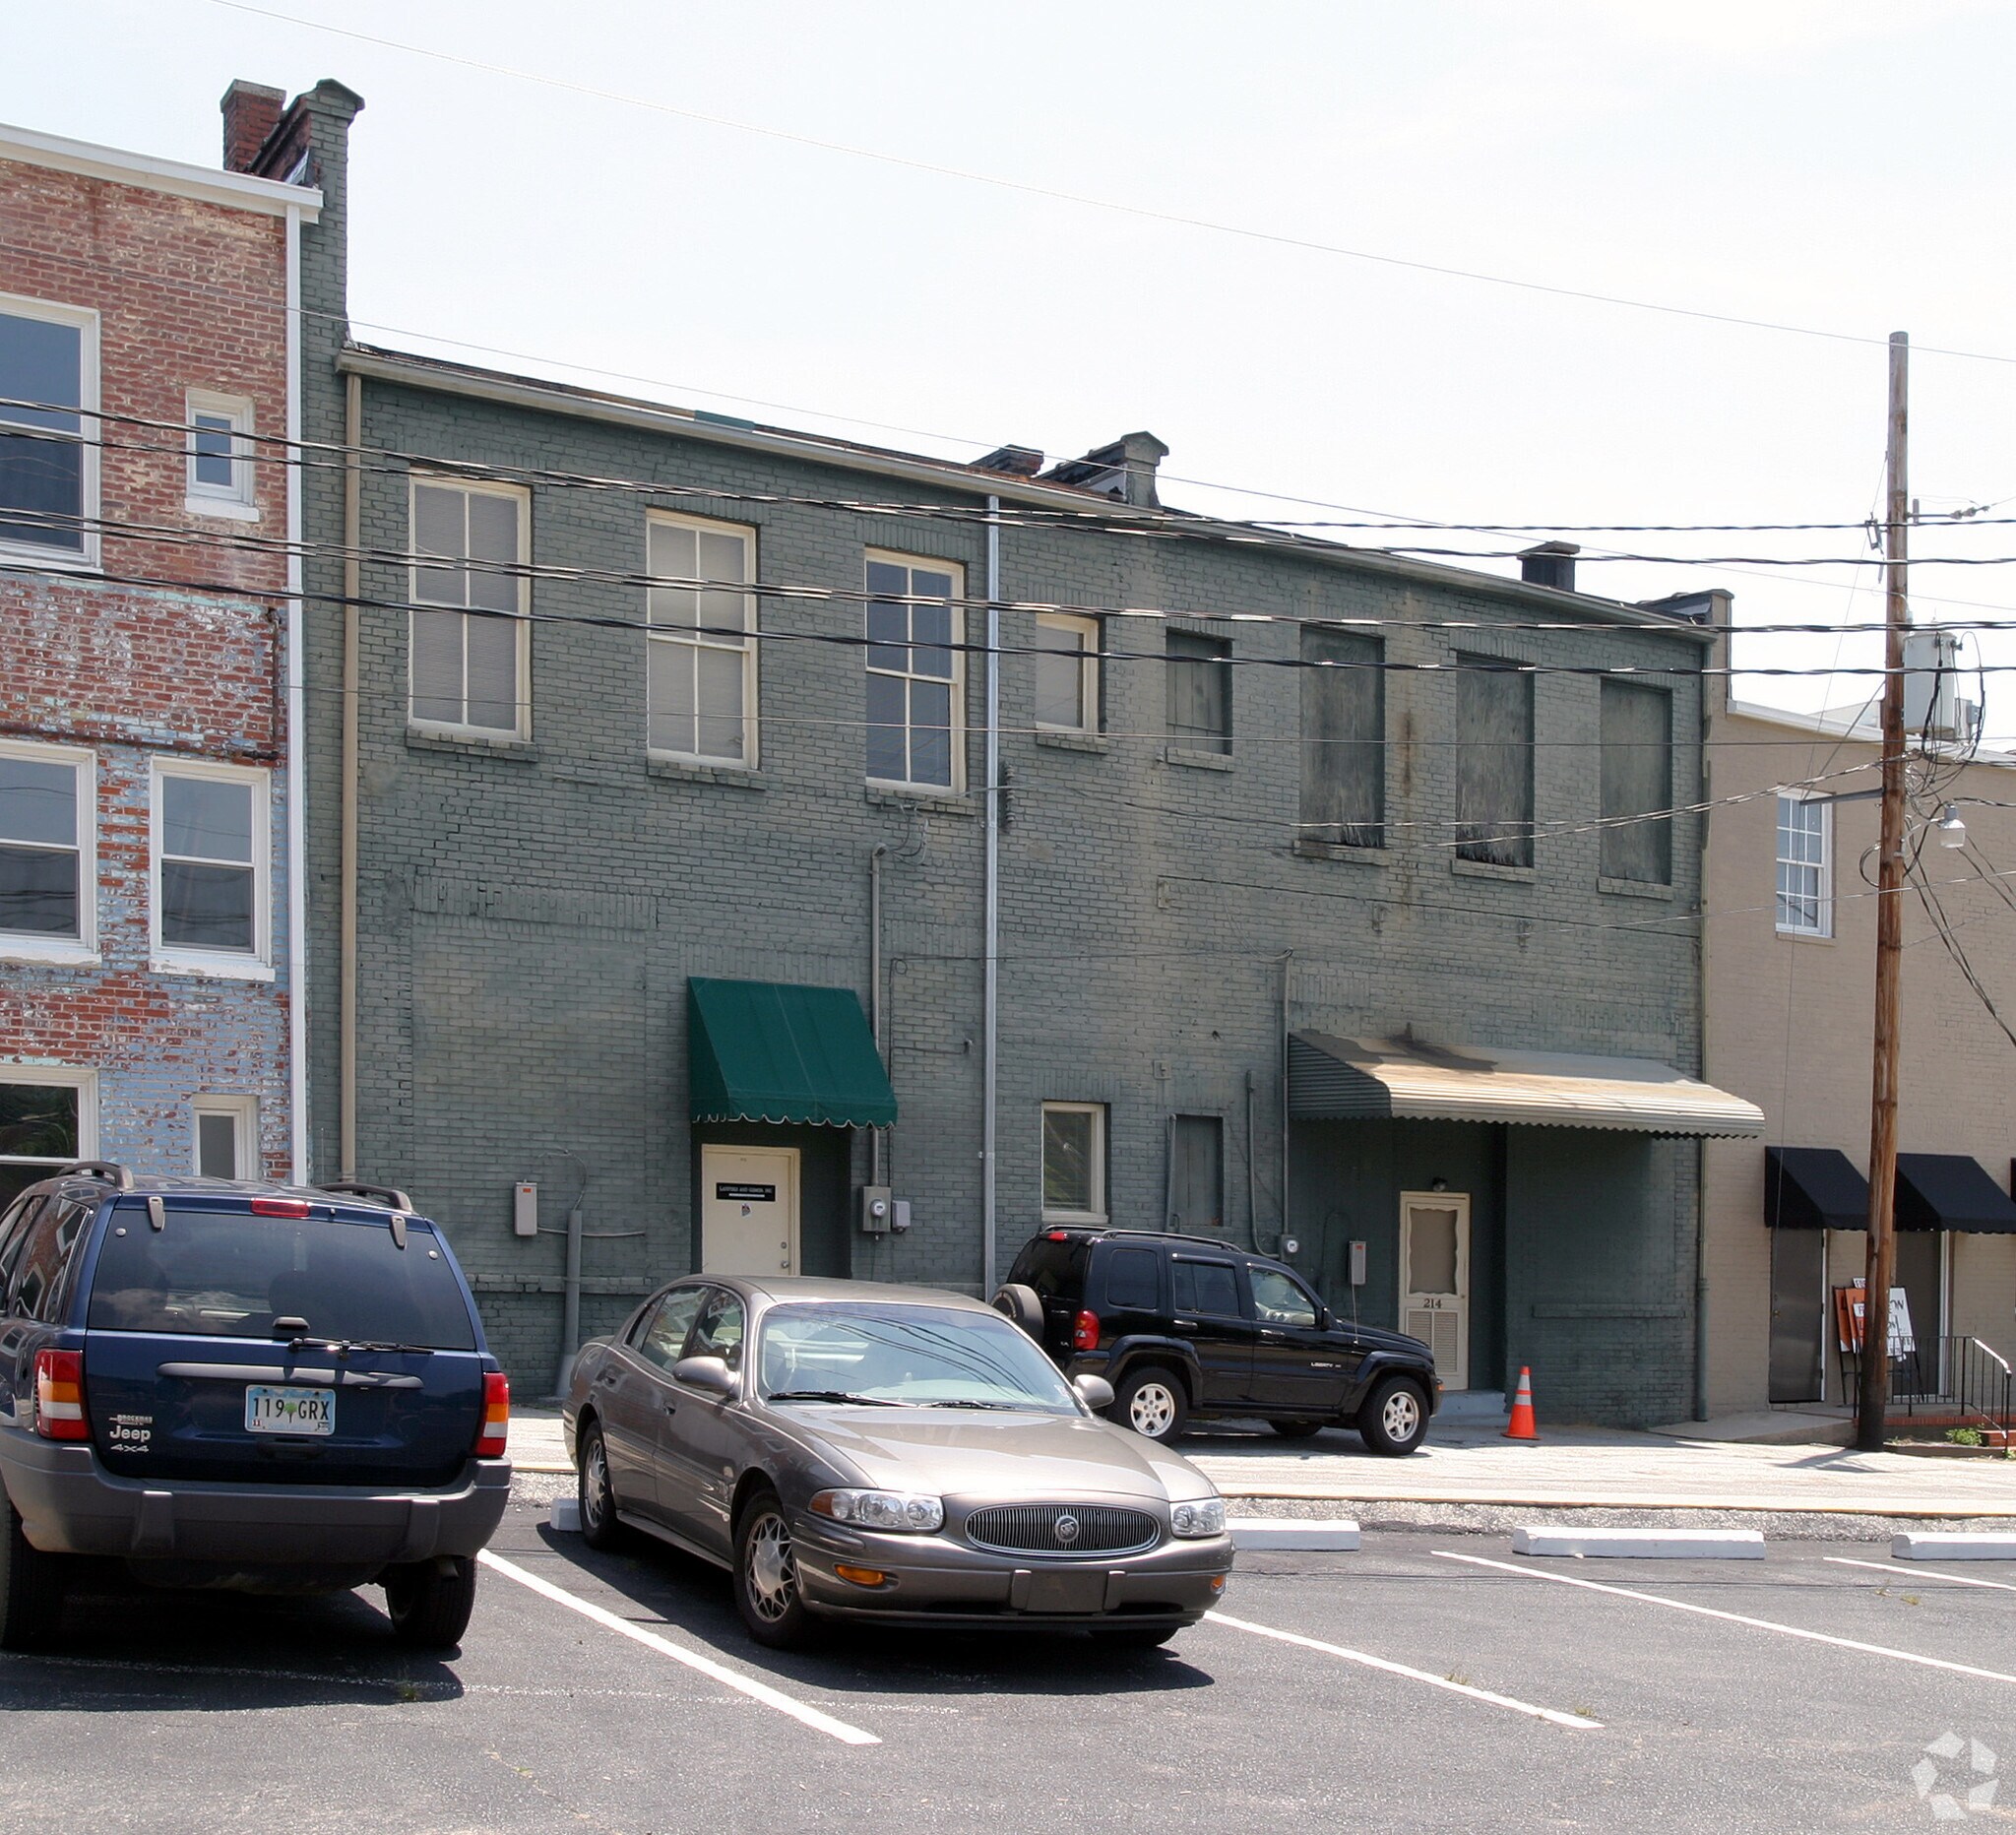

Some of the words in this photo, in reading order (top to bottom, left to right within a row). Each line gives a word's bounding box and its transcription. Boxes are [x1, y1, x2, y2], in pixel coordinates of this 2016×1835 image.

[1423, 1298, 1442, 1308] 214
[253, 1397, 284, 1419] 119
[298, 1400, 330, 1421] GRX
[109, 1425, 152, 1443] Jeep
